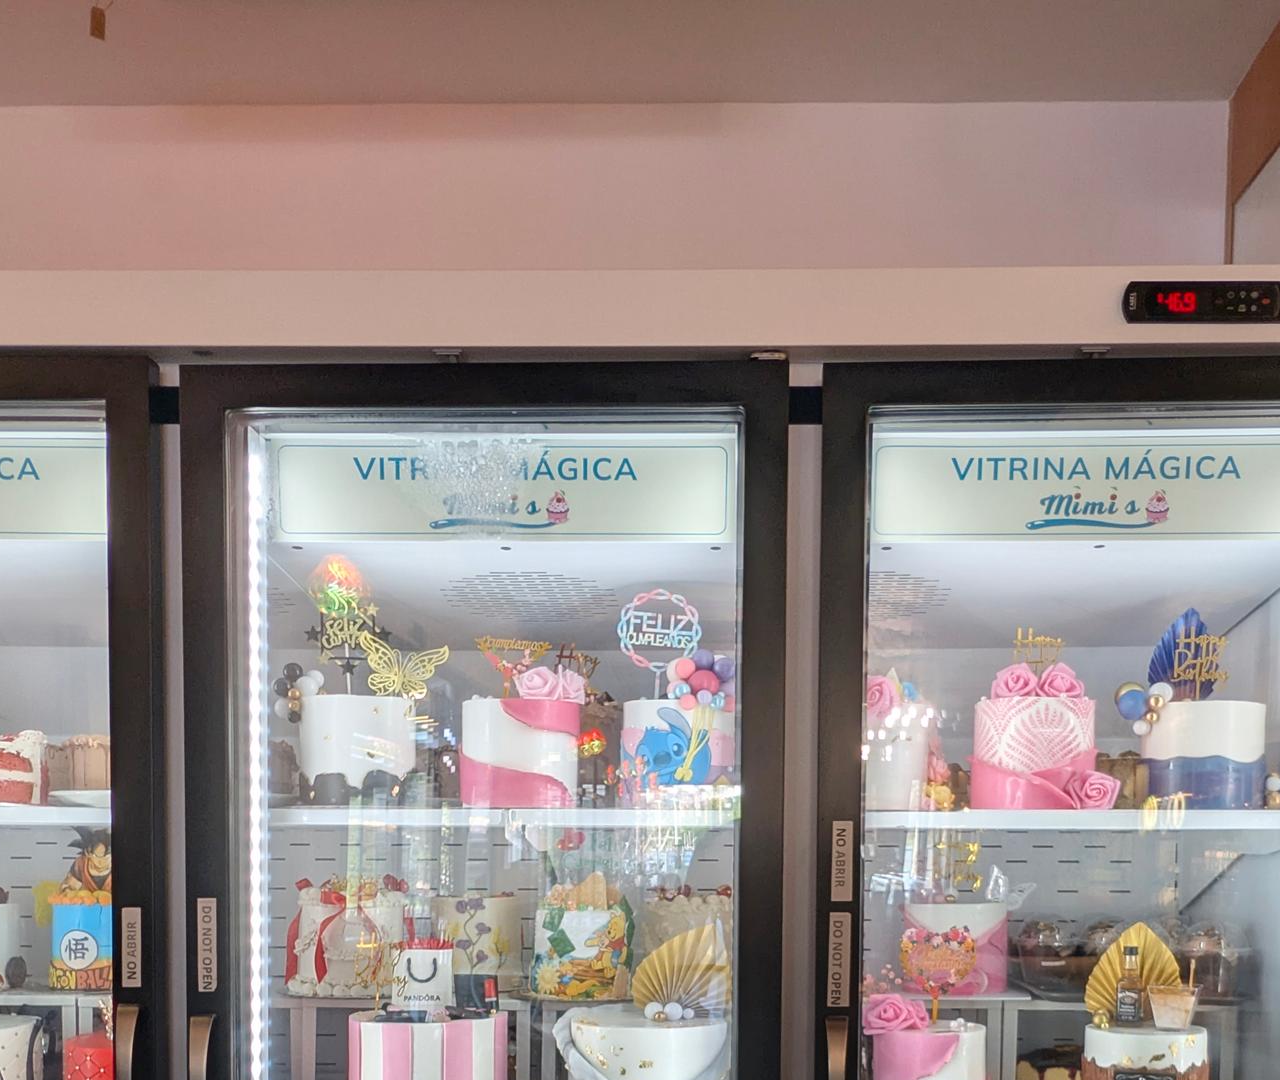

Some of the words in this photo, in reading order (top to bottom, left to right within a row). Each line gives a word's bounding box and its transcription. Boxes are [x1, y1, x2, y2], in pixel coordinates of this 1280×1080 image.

[951, 456, 1091, 481] VITRINA
[1104, 449, 1241, 480] MÁGICA
[628, 611, 695, 635] FELIZ
[836, 828, 847, 847] NO
[834, 851, 846, 888] ABRIR
[202, 906, 212, 924] DO
[126, 921, 137, 958] ABRIR
[202, 930, 212, 953] NOT
[832, 920, 843, 938] DO
[65, 936, 89, 961] 悟
[831, 942, 842, 968] NOT
[127, 961, 137, 980] NO
[202, 958, 213, 990] OPEN
[830, 972, 841, 1005] OPEN
